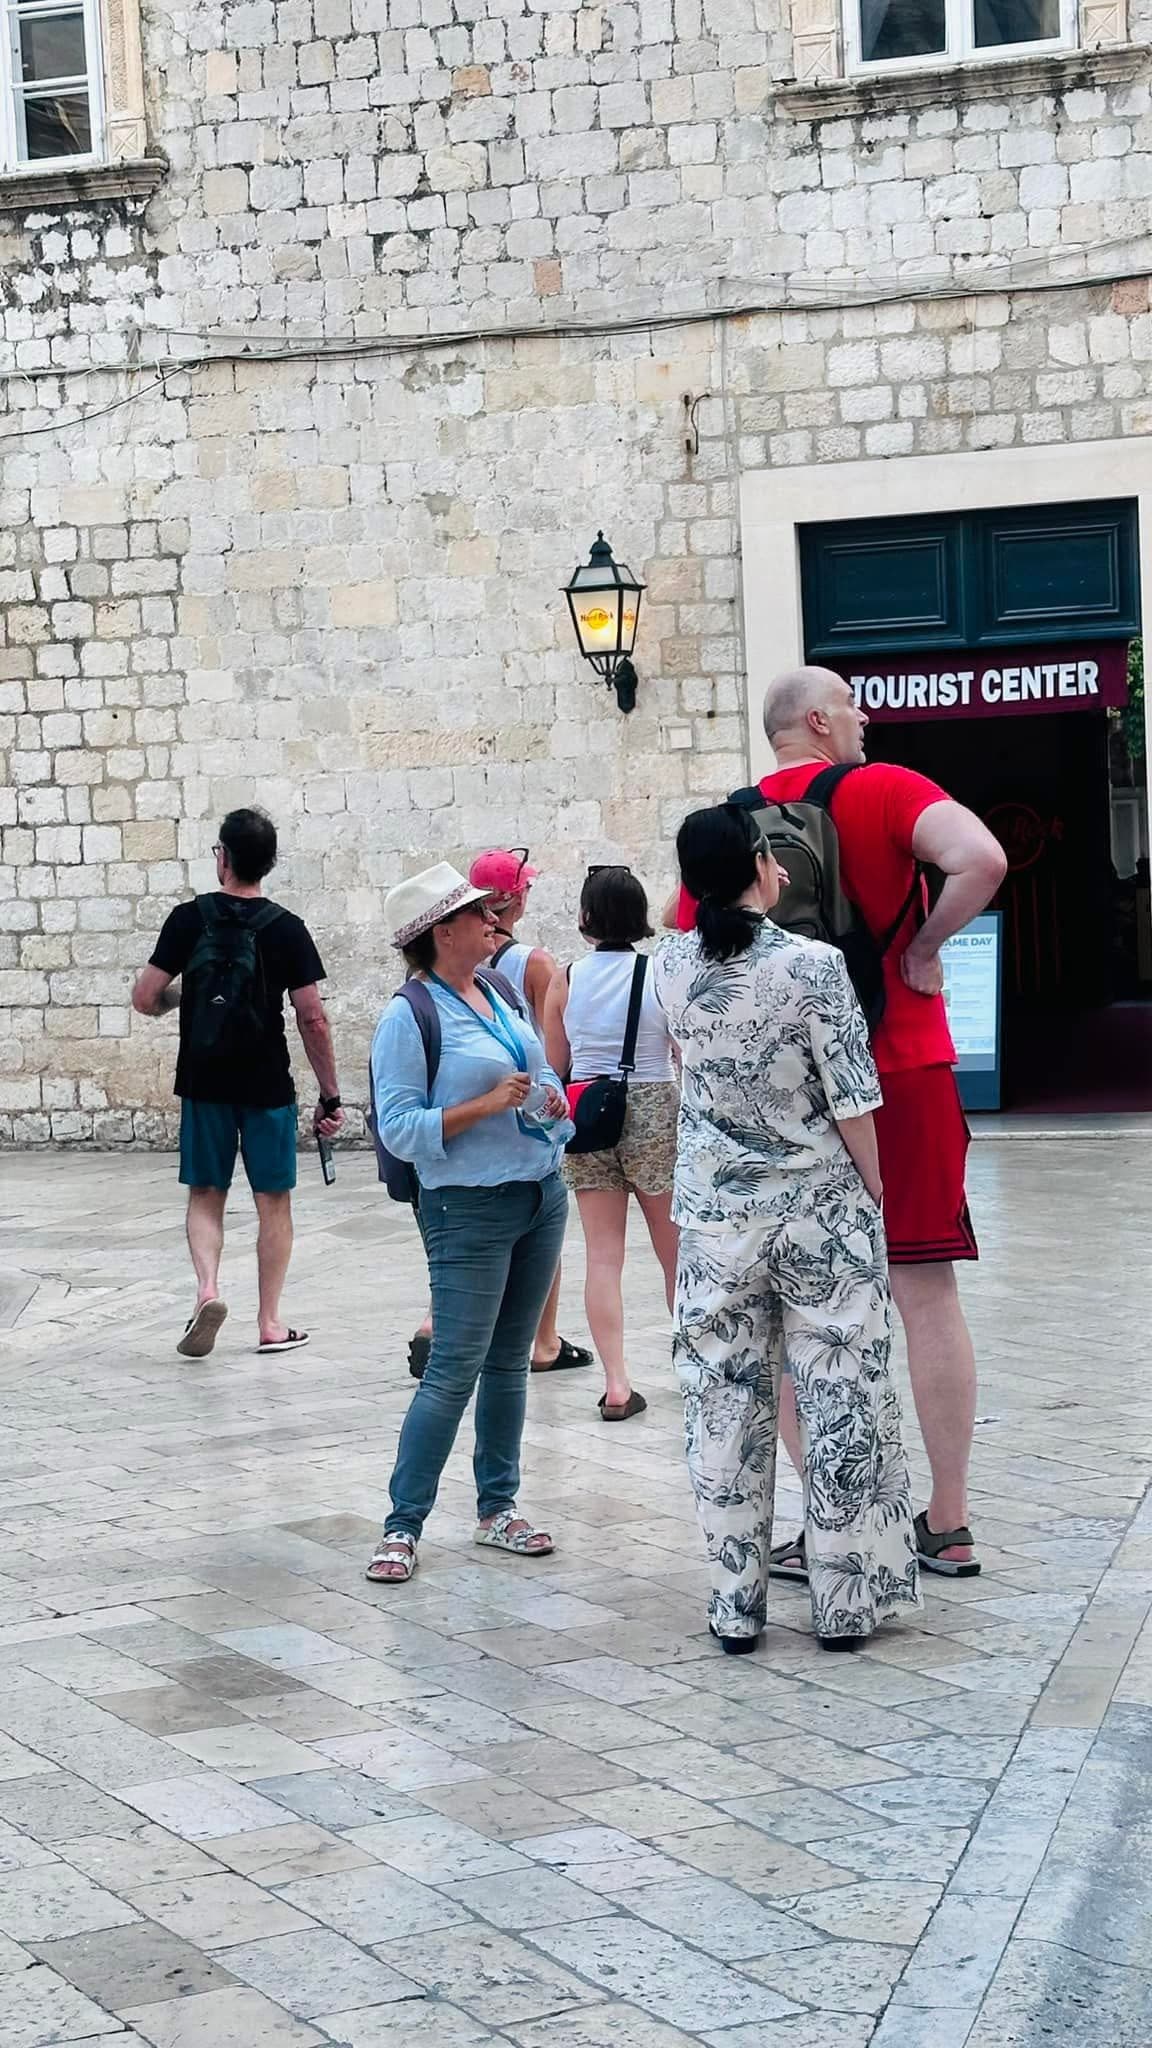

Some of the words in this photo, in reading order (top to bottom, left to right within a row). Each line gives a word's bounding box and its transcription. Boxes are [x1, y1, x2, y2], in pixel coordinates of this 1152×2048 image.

[851, 671, 974, 709] TOURIST
[981, 660, 1099, 703] CENTER
[943, 937, 969, 947] AME
[970, 936, 993, 947] DAY
